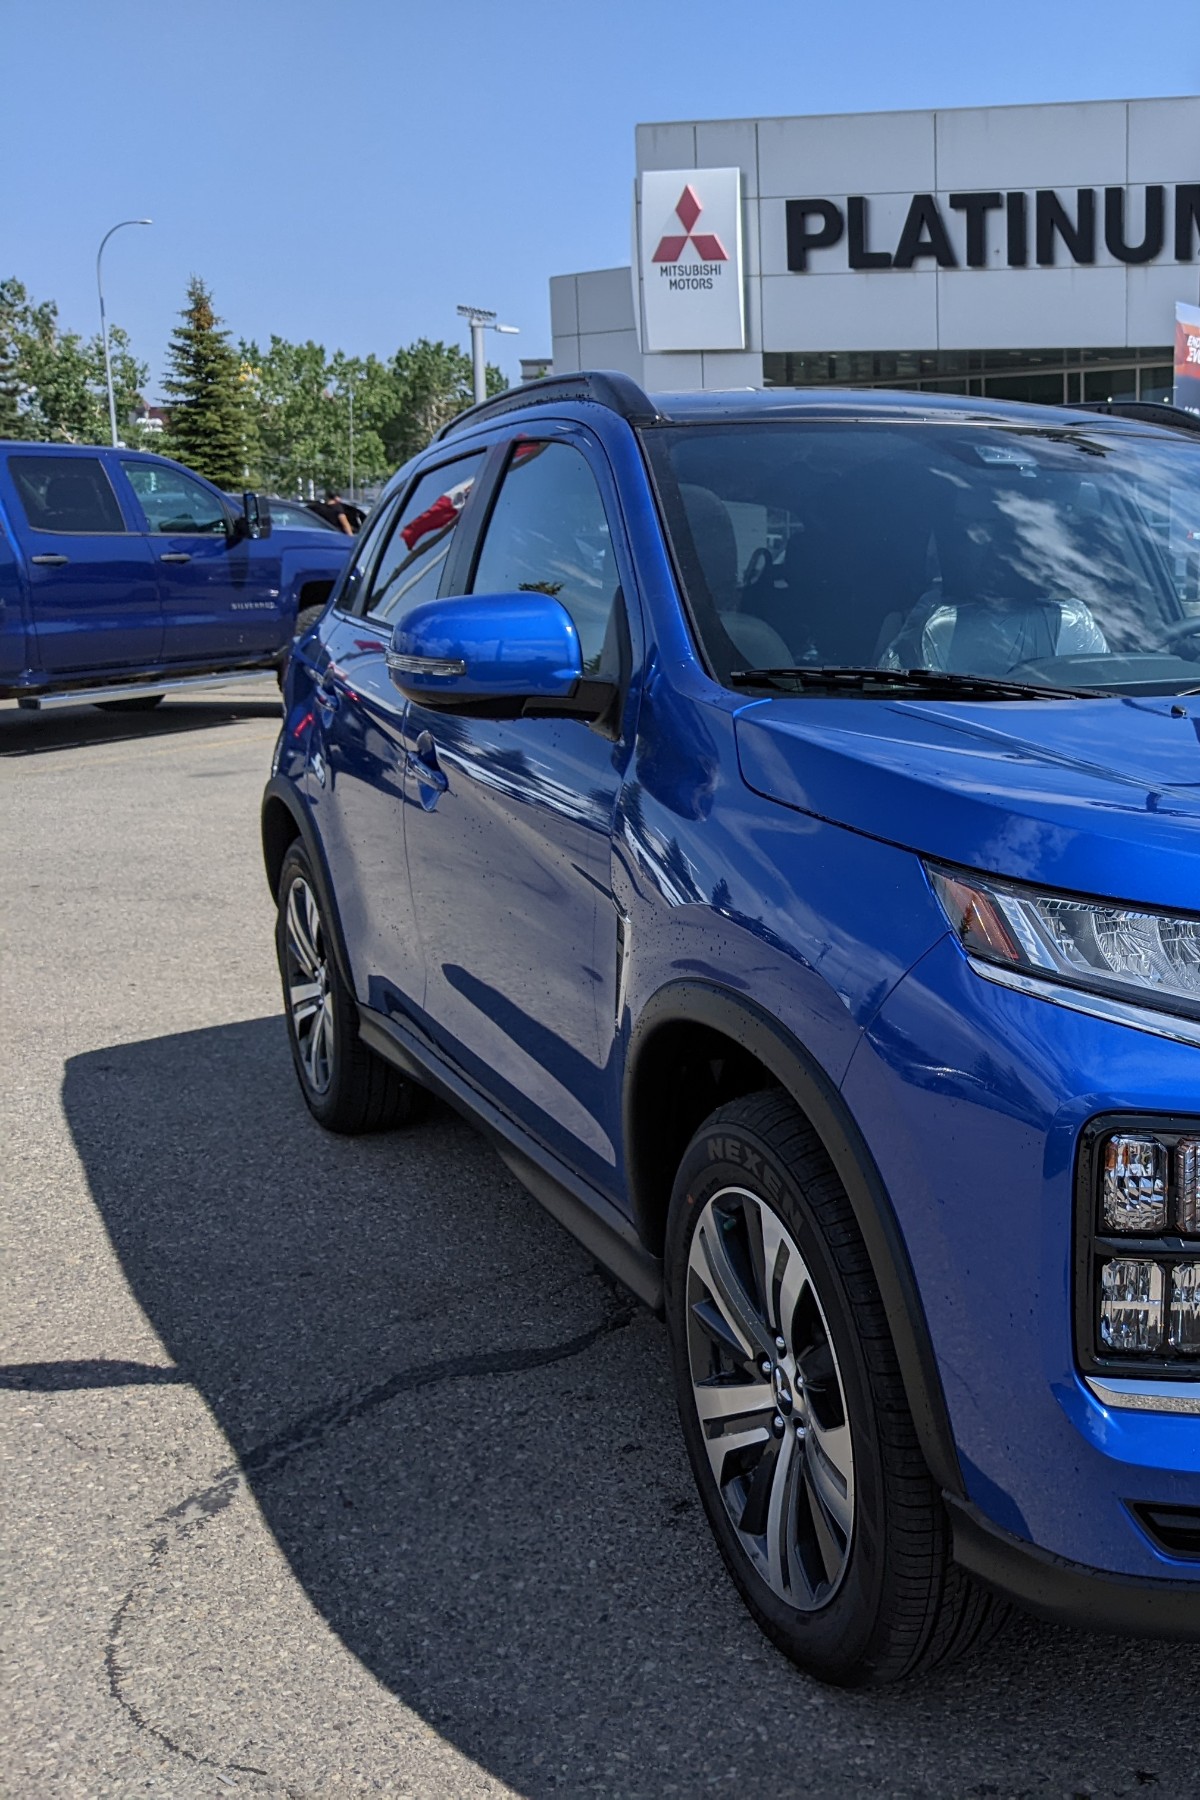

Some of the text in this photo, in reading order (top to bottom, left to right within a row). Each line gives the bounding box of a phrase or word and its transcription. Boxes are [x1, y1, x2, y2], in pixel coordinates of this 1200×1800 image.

[659, 264, 722, 277] MITSUBISHI
[669, 278, 714, 290] MOTORS
[706, 1136, 807, 1236] NEXEN
